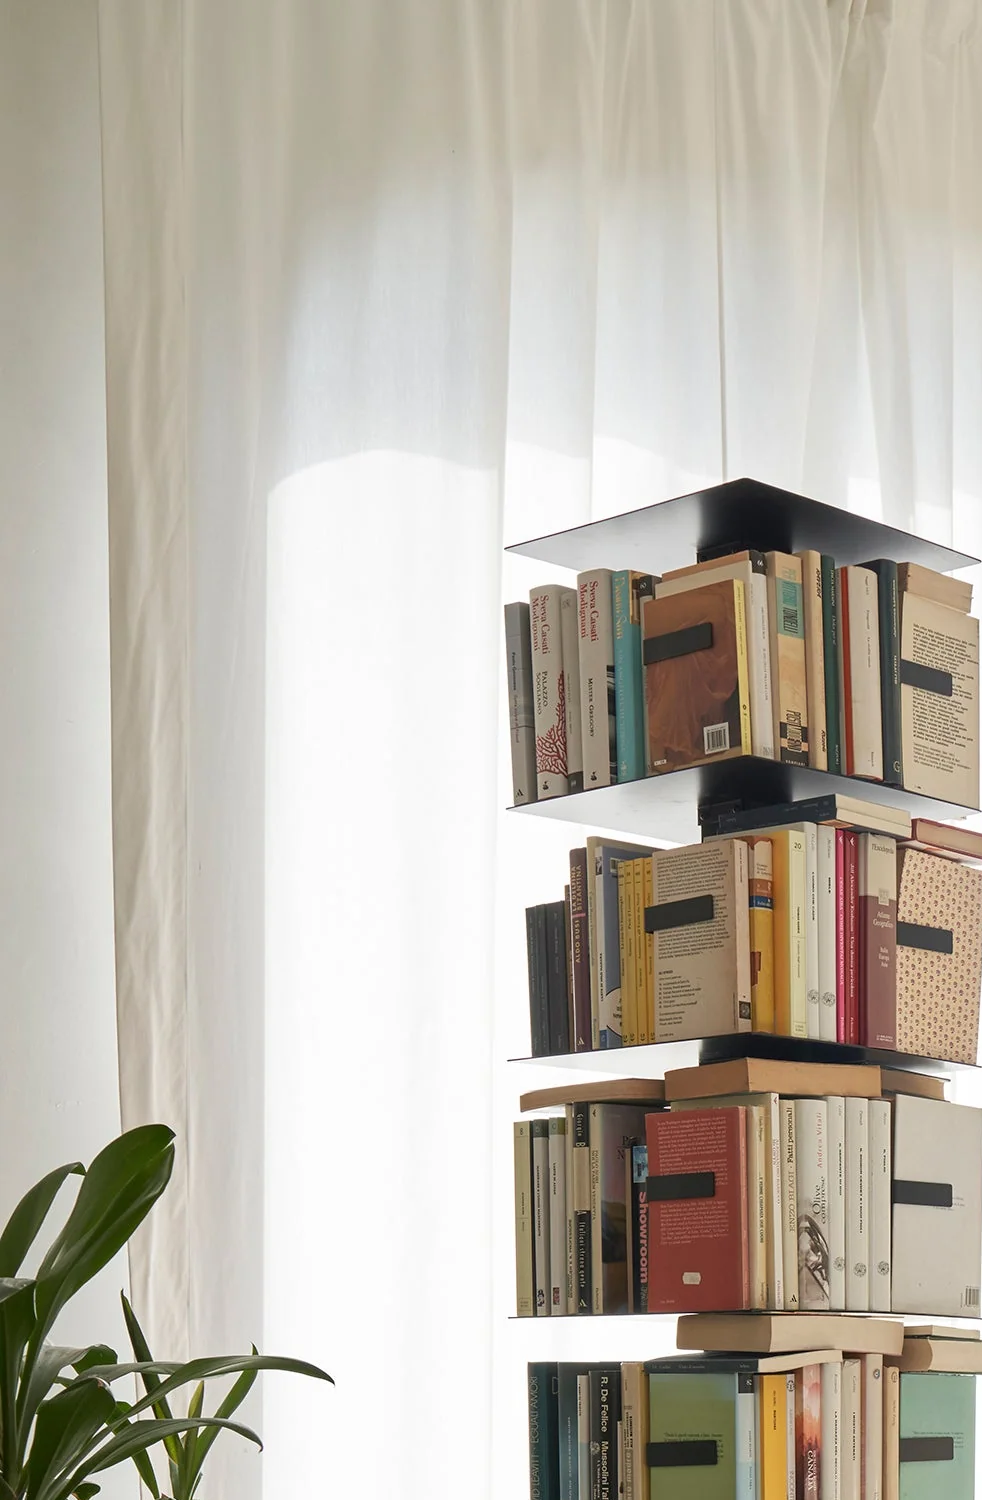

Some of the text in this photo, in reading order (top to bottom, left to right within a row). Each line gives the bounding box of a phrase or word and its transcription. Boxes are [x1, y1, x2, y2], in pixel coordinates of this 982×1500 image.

[532, 597, 540, 651] Modignani
[538, 595, 551, 655] Sveva Casati
[580, 584, 588, 640] Modignani
[581, 581, 599, 642] Sveva Casati
[783, 607, 799, 634] TONDELLI
[535, 672, 543, 715] SOGLIANO
[541, 671, 549, 707] PALAZZO
[576, 1113, 584, 1137] Giorgio
[786, 1107, 794, 1143] personali
[788, 1203, 796, 1233] ENZO
[812, 1184, 821, 1215] Olive
[578, 1221, 587, 1246] Italiani
[638, 1191, 649, 1284] showroom
[578, 1247, 587, 1269] strana
[530, 1376, 540, 1444] EGUALI AMORI
[600, 1376, 609, 1432] R. De Felice
[531, 1454, 540, 1486] LEAVITT
[600, 1440, 609, 1485] Mussolini
